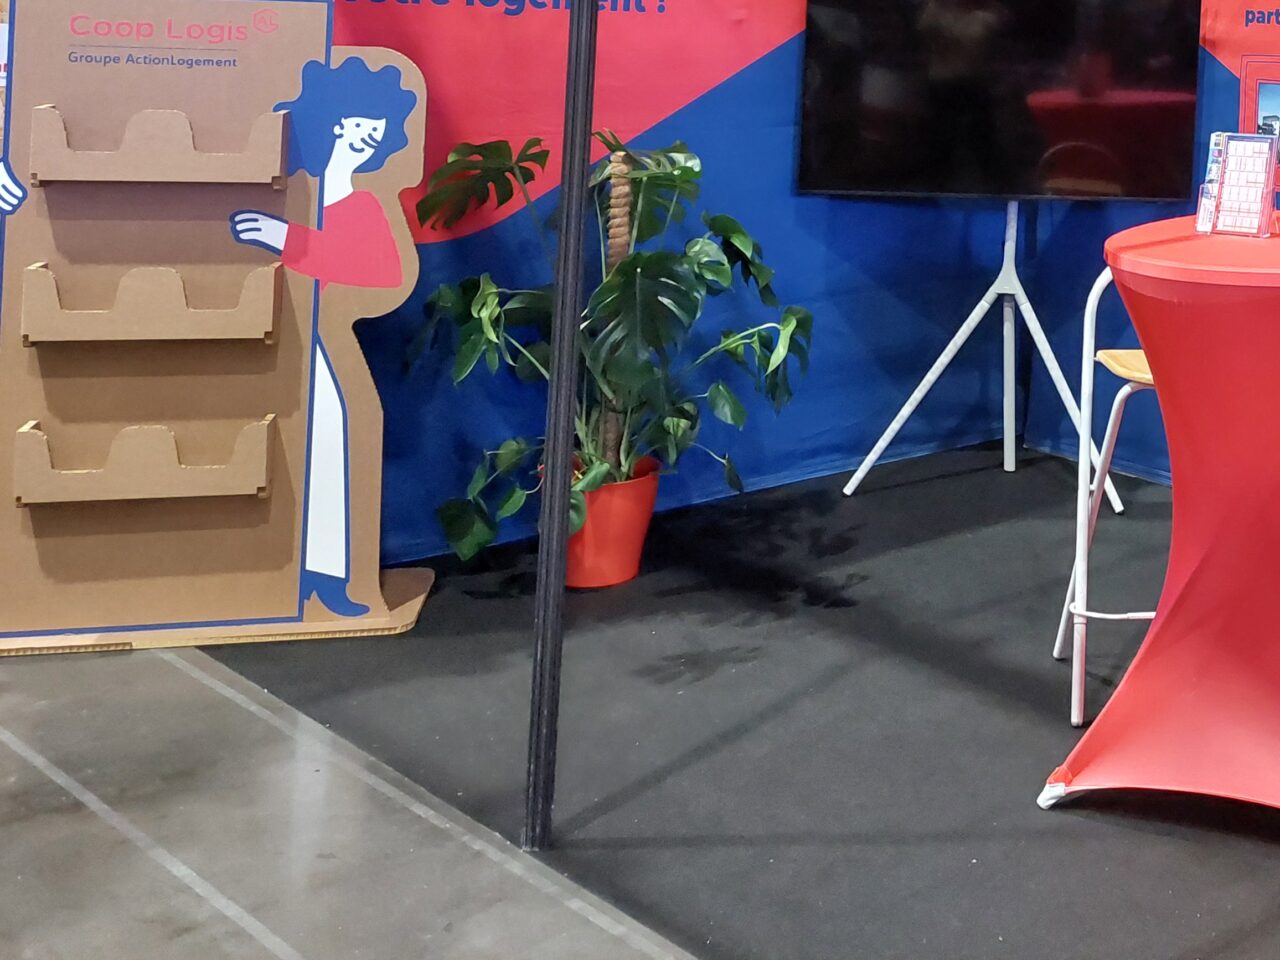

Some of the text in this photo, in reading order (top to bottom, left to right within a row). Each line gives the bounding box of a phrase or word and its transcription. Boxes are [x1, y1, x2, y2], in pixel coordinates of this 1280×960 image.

[69, 15, 155, 41] Coop
[166, 17, 249, 44] Logis
[68, 51, 239, 69] Groupe ActionLogement
